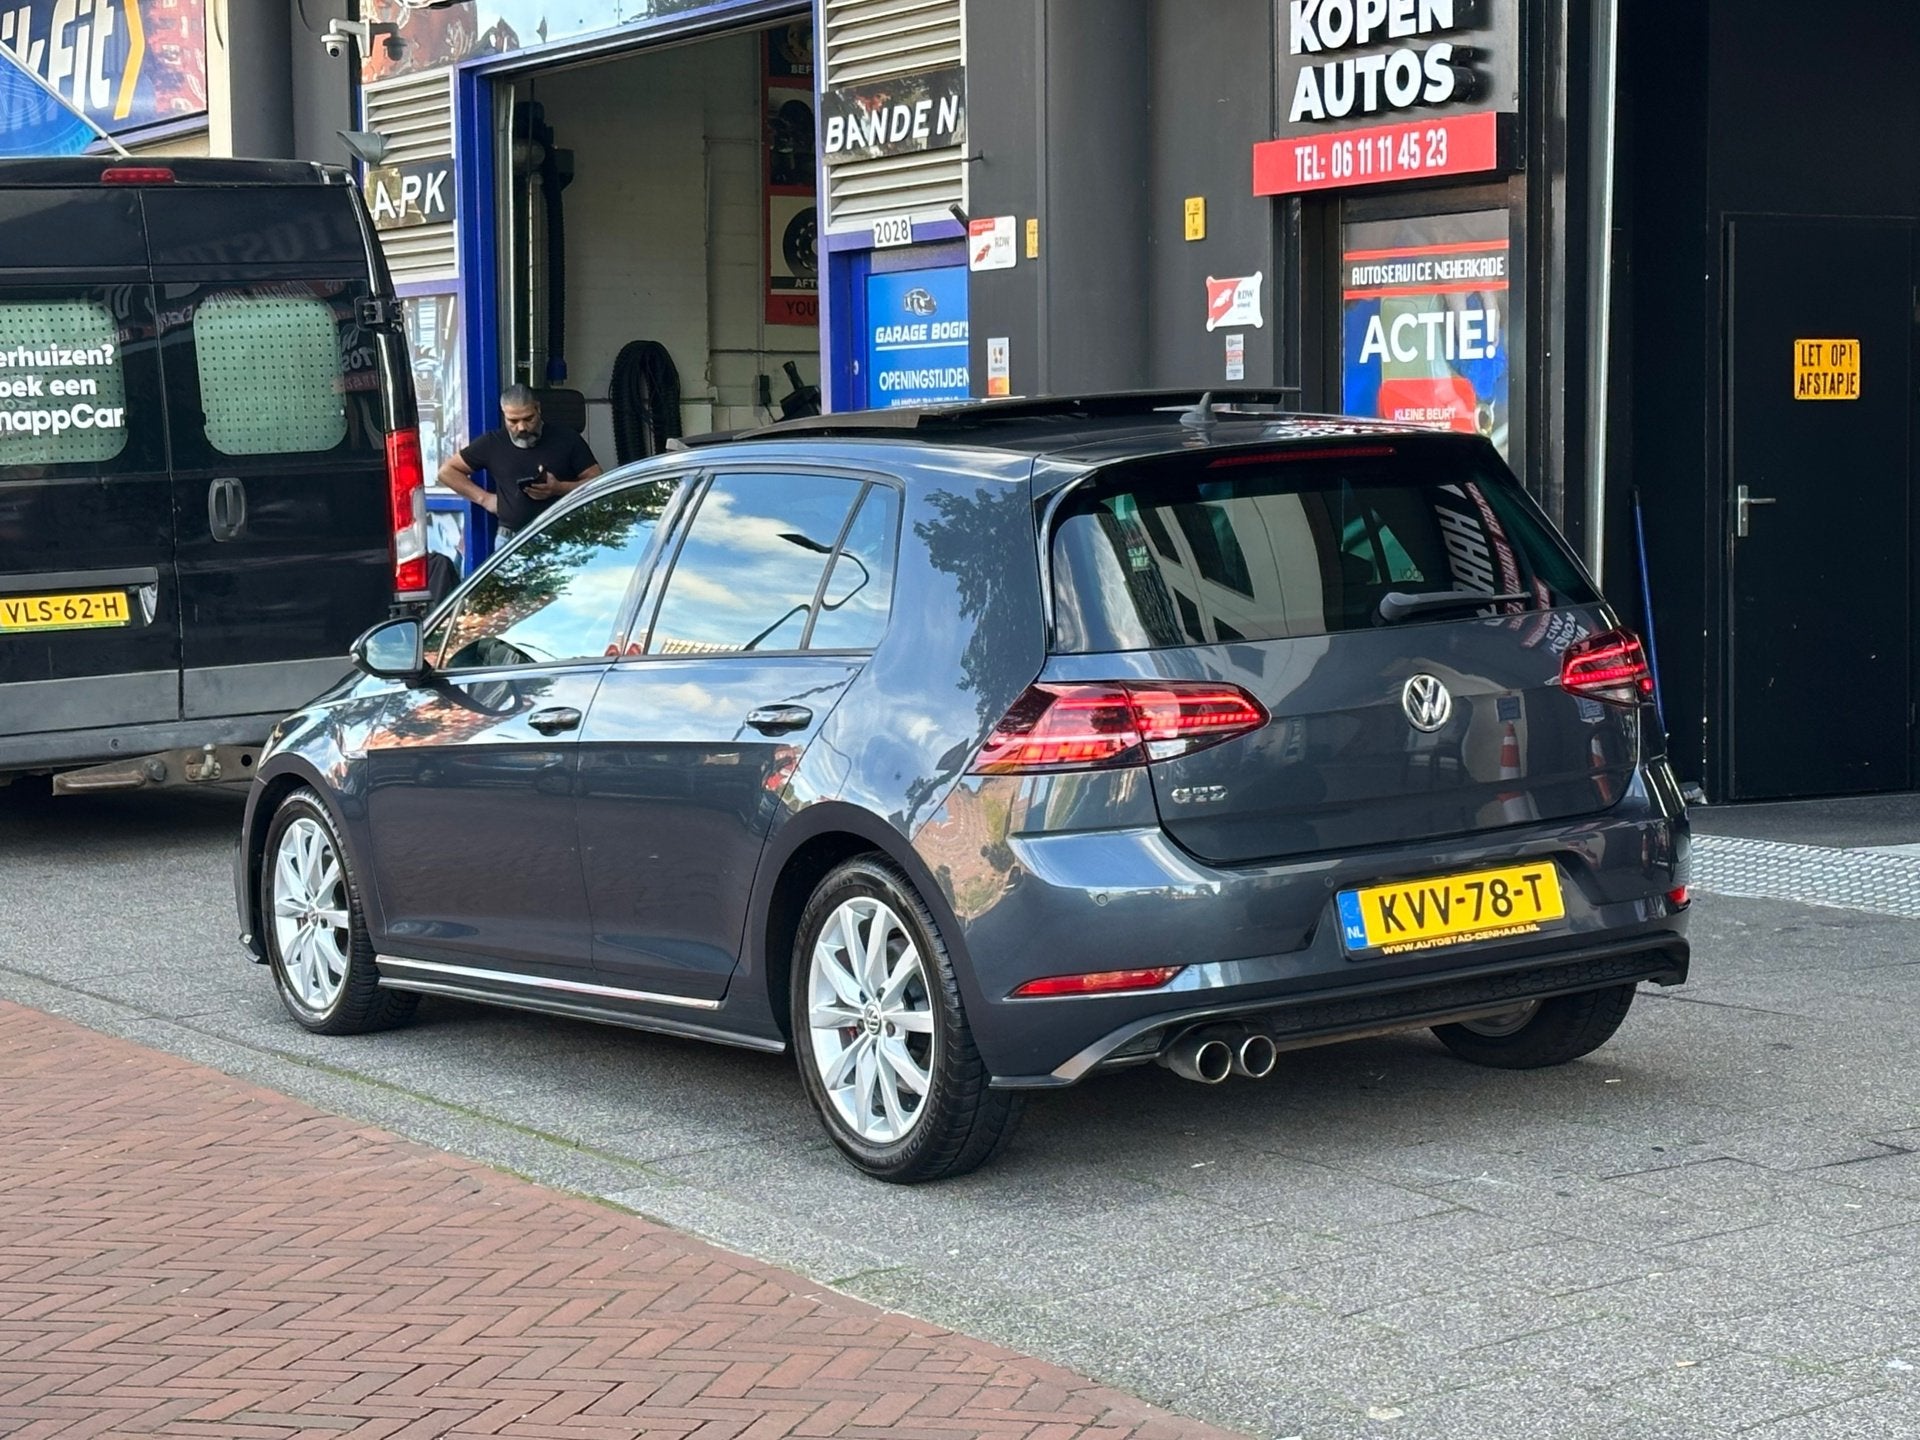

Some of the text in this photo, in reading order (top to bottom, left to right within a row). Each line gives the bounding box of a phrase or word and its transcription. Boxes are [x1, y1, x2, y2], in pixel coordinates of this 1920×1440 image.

[1290, 0, 1454, 55] KOPEN
[1289, 42, 1455, 123] AUTOS
[825, 95, 958, 153] BANDEN
[1294, 128, 1448, 182] TEL: 06 11 11 45 23
[374, 170, 447, 221] APK
[875, 220, 909, 243] 2028
[1352, 256, 1505, 286] AUTOSERVICE NEHERKADE
[875, 324, 928, 344] GARAGE
[1359, 309, 1496, 364] ACTIE!
[1801, 344, 1822, 366] LET
[50, 378, 97, 395] een
[879, 367, 969, 391] OPENINGSTIJDEN
[1799, 372, 1857, 395] AFSTAPJE
[1394, 405, 1456, 421] KLEINE BEURT
[5, 596, 119, 624] VLS-62-H
[1378, 873, 1543, 934] KVV-78-T
[1347, 926, 1365, 939] NL
